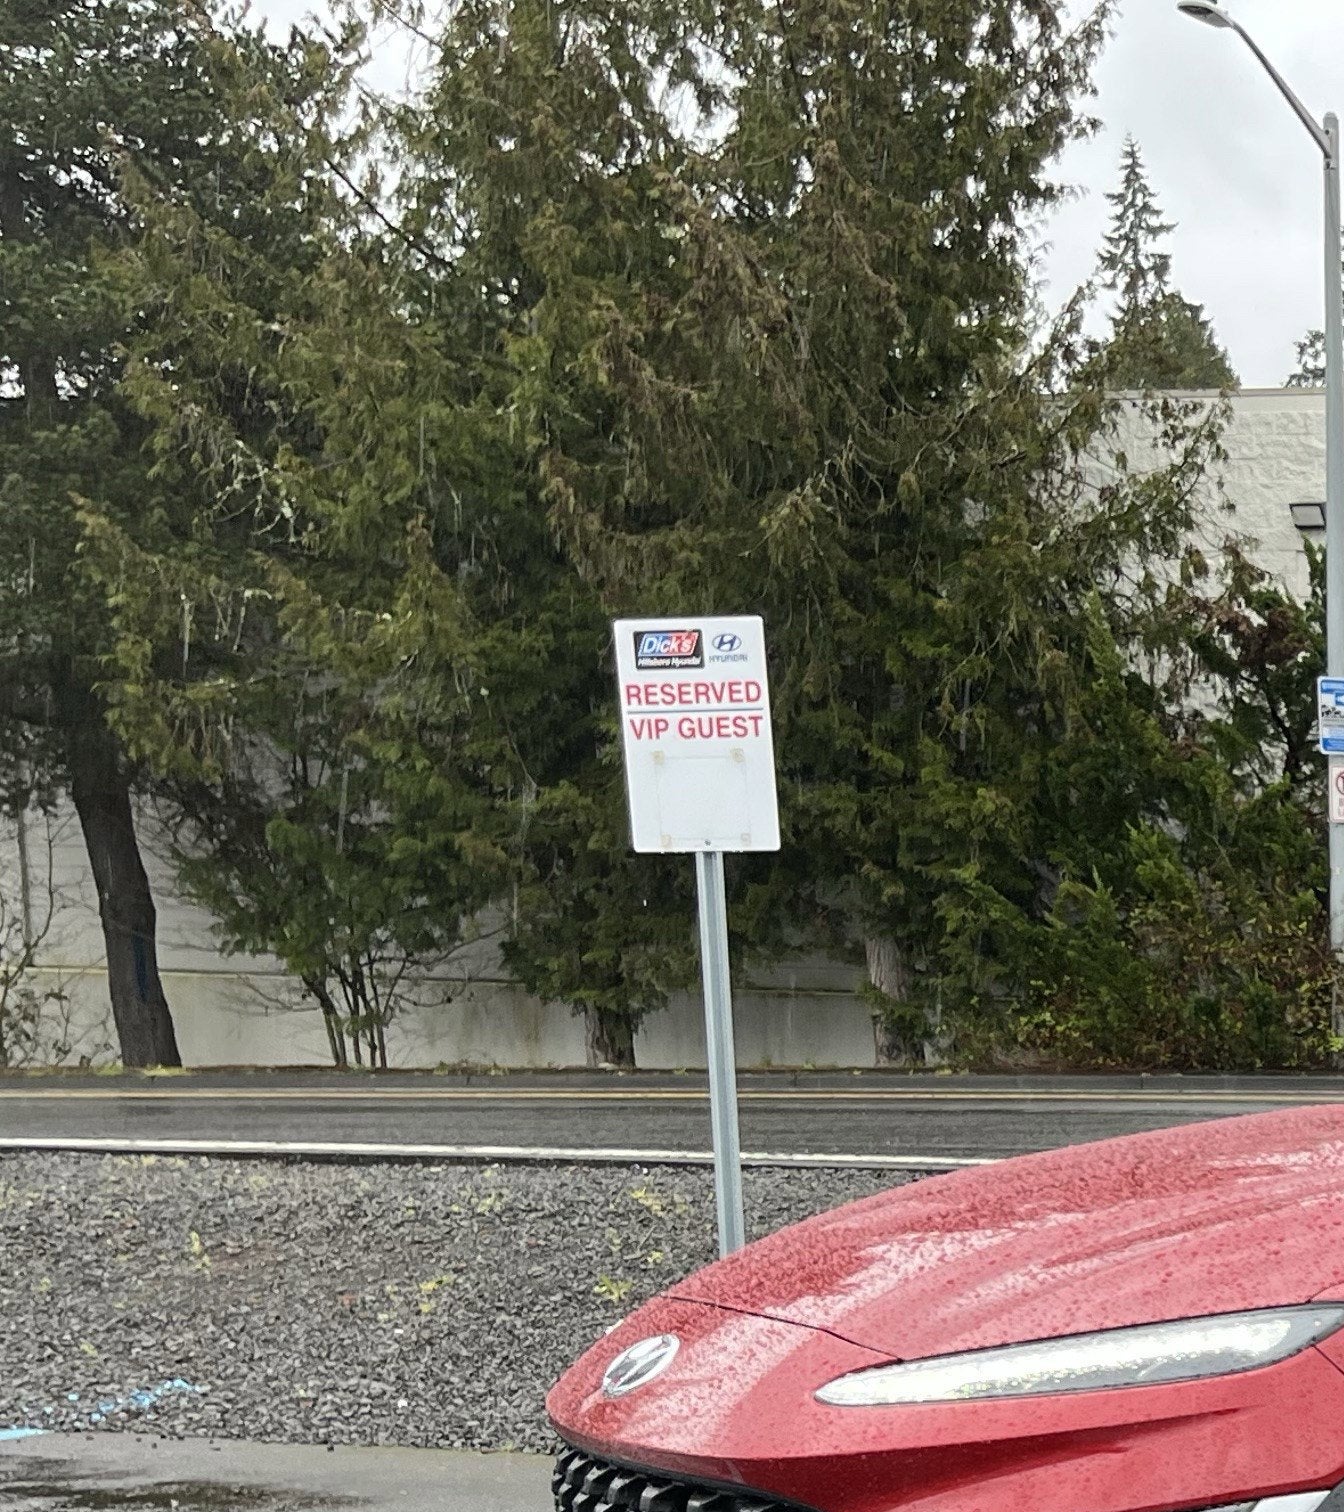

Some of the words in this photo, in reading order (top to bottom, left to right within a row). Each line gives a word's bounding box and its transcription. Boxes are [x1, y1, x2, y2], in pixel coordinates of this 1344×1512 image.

[625, 680, 762, 706] RESERVED
[630, 719, 669, 740] VIP
[677, 716, 763, 739] GUEST
